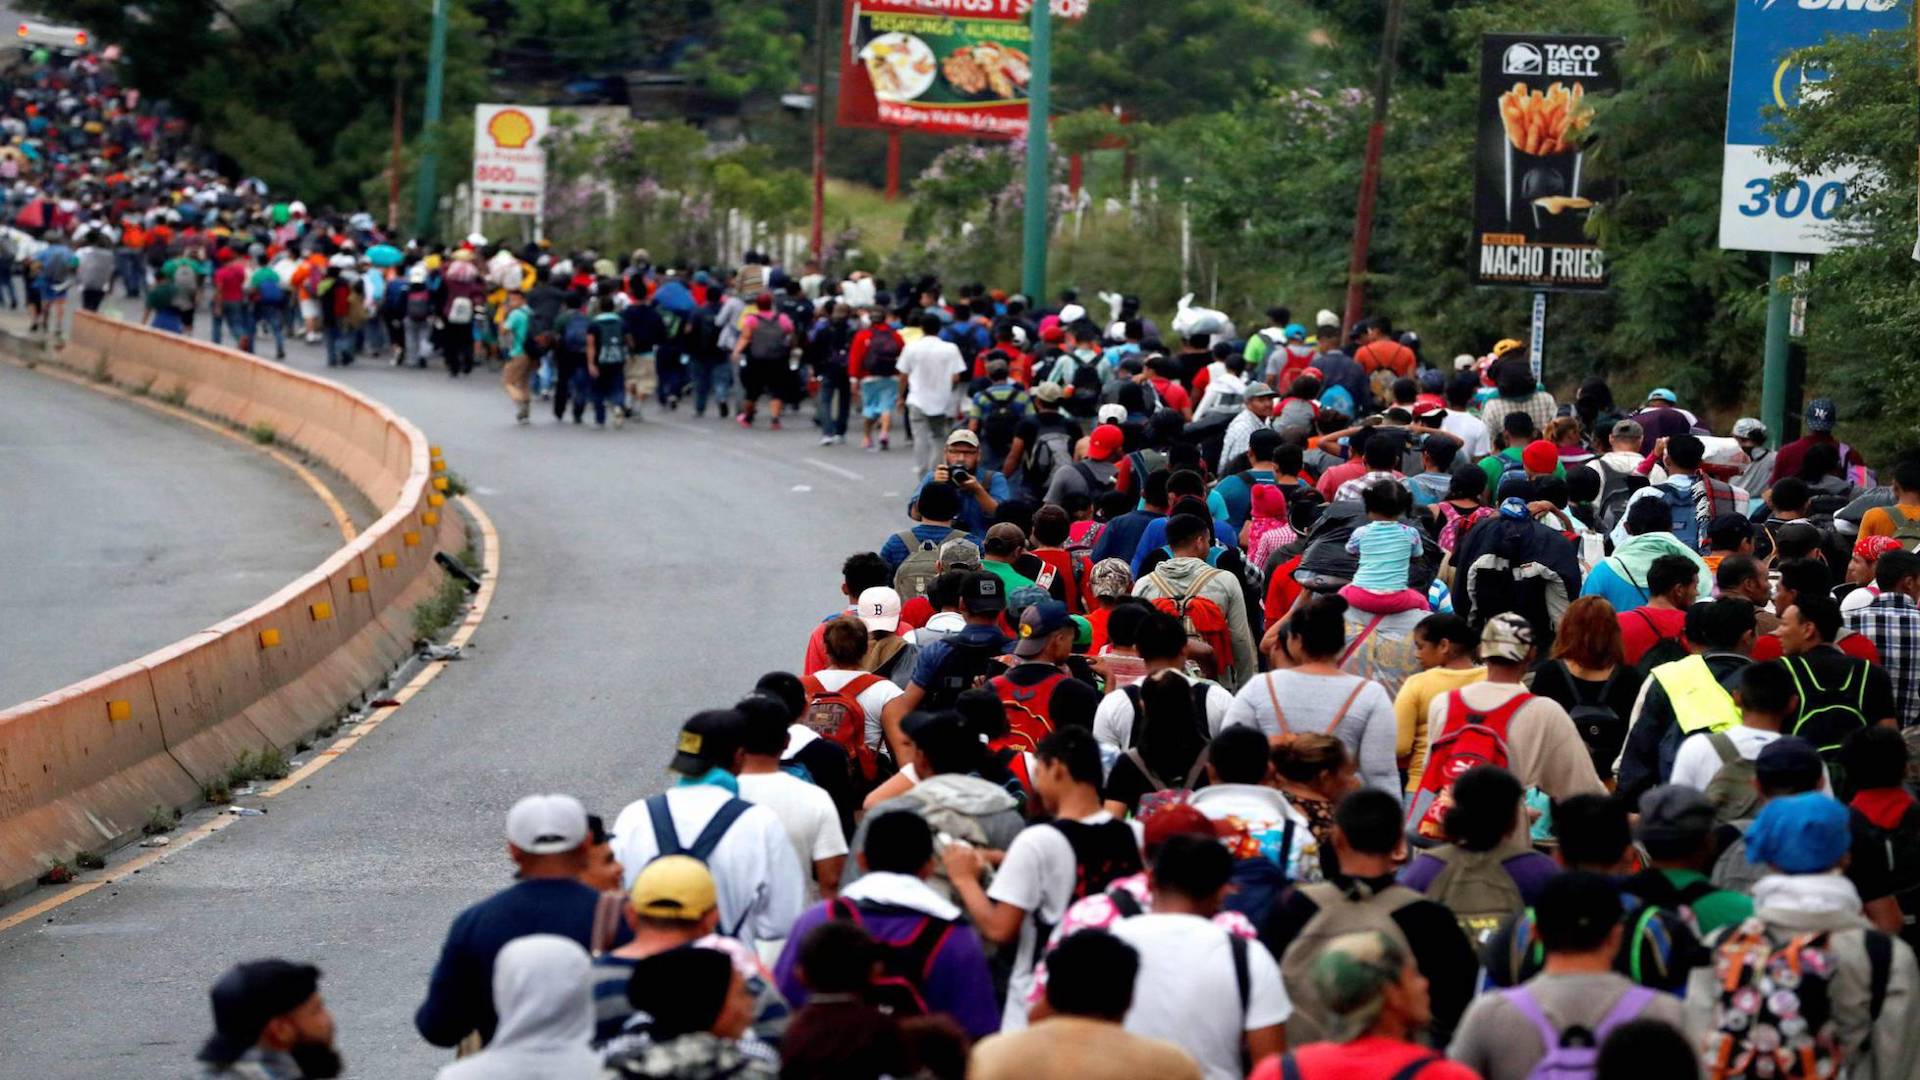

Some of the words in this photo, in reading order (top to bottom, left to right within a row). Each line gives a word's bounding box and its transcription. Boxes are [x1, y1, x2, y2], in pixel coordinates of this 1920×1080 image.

[1544, 44, 1601, 61] TACO
[1546, 60, 1599, 76] BELL
[1480, 245, 1544, 276] NACHO
[1551, 247, 1604, 278] FRIES
[874, 603, 883, 616] B
